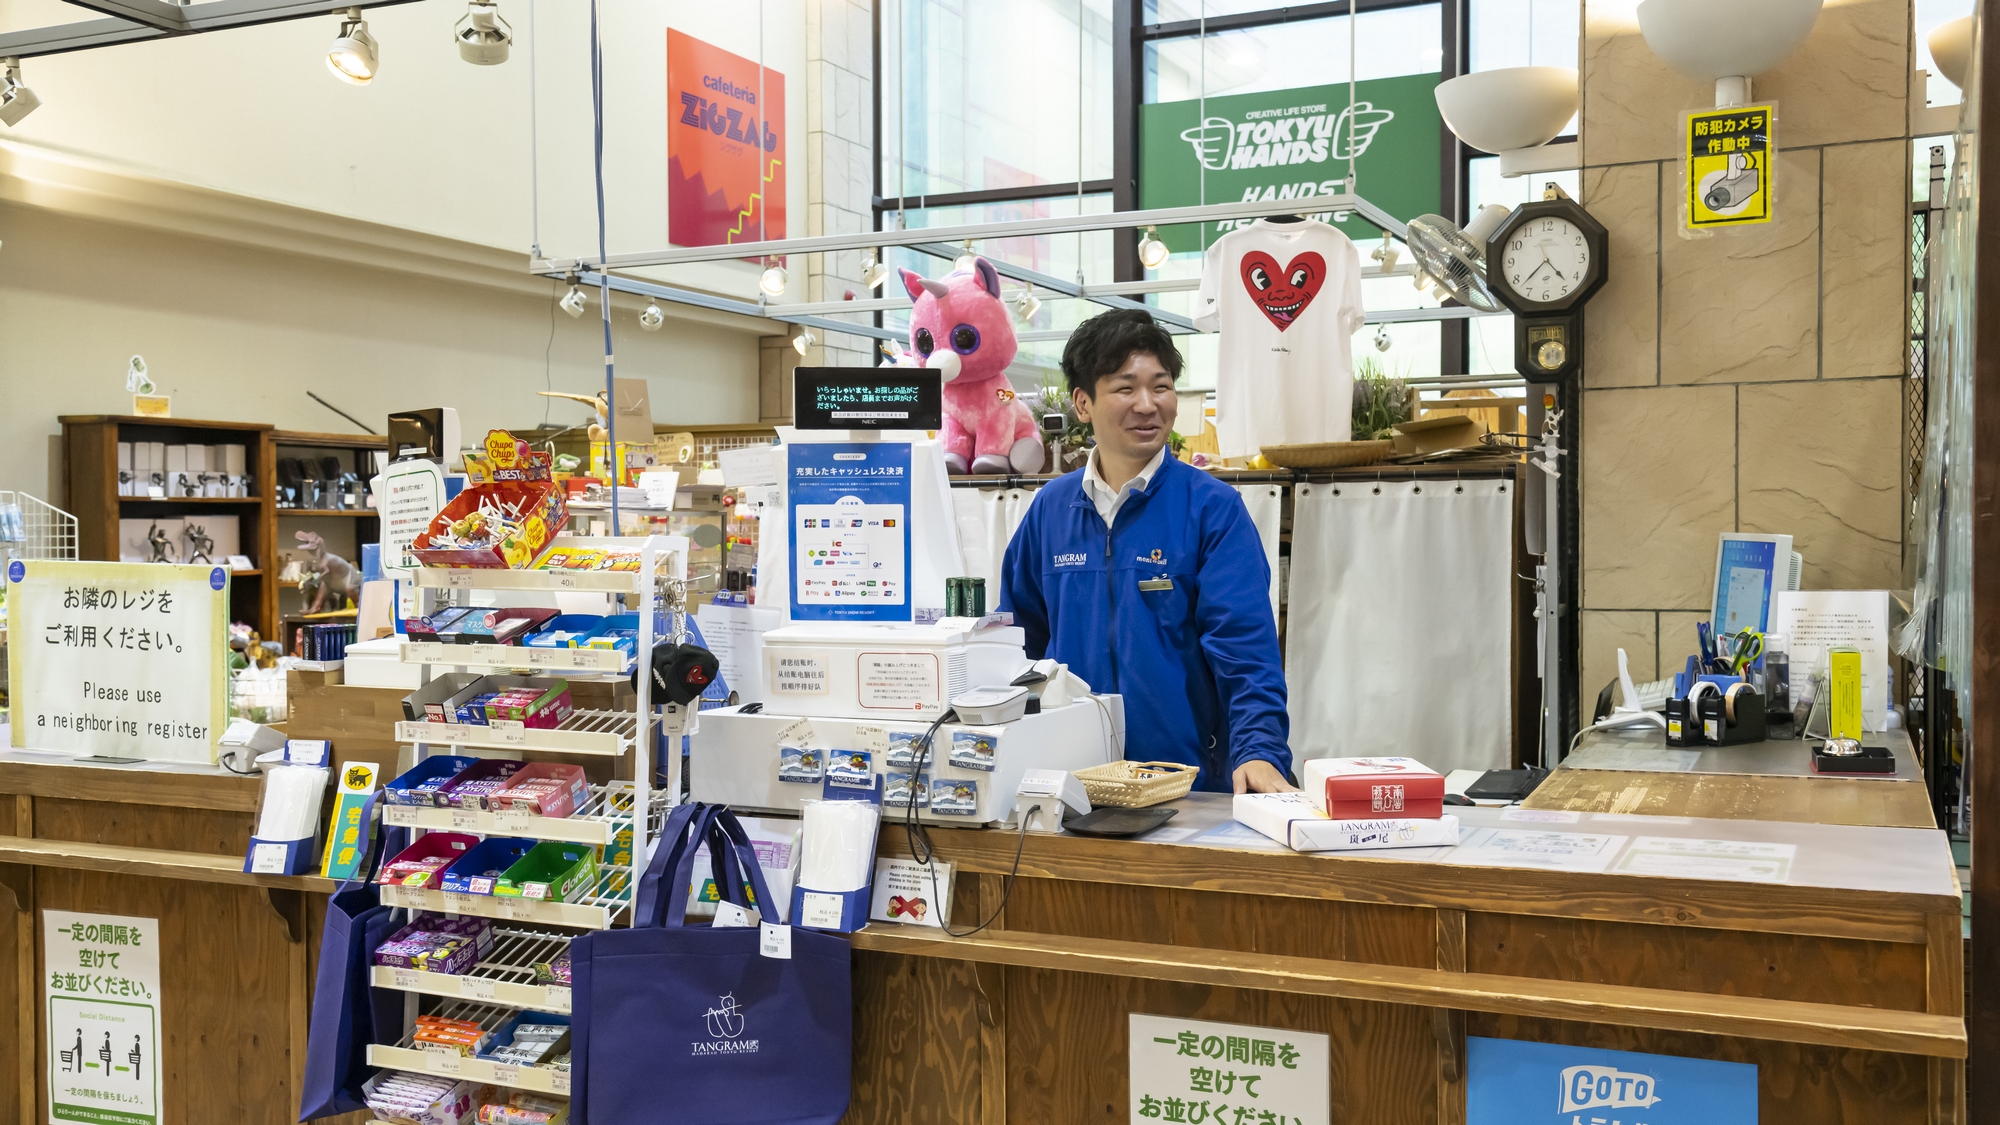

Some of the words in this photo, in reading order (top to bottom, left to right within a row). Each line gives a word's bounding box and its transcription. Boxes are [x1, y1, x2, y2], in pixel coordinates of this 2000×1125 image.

[703, 74, 756, 105] cafeteria
[1246, 108, 1282, 120] CREATIVE
[1283, 106, 1299, 117] LIFE
[1300, 104, 1327, 116] STORE
[1236, 114, 1336, 146] TOKYU
[1695, 116, 1763, 136] 防犯カメラ
[1708, 135, 1750, 154] 作動中
[1231, 138, 1330, 170] HANDS
[1241, 179, 1344, 202] HANDS
[1524, 226, 1533, 238] 11
[1541, 221, 1554, 232] 12
[1563, 224, 1568, 235] 1
[1511, 240, 1522, 251] 10
[1575, 236, 1582, 247] 2
[1507, 257, 1515, 269] 9
[1578, 253, 1586, 264] 3
[1512, 274, 1520, 285] 8
[1573, 271, 1580, 282] 4
[1526, 287, 1533, 298] 7
[1542, 290, 1550, 301] 6
[1560, 285, 1568, 296] 5
[816, 386, 919, 394] いらっしゃいませ。お探しの品がご
[816, 402, 841, 410] ださい。
[490, 440, 513, 450] Chupa
[491, 449, 515, 461] Chups
[500, 470, 520, 480] BEST
[796, 467, 904, 476] 充実したキャッシュレス決済
[1054, 553, 1087, 563] TANGRAM
[63, 586, 173, 614] お隣のレジを
[45, 623, 183, 653] ご利用ください。
[780, 658, 817, 667] 请您结账时，
[777, 670, 825, 679] 从结账电脑往后
[84, 681, 129, 701] Please
[137, 688, 162, 703] use
[781, 682, 822, 691] 按顺序排好队
[428, 713, 443, 721] No.1
[37, 714, 46, 727] a
[53, 712, 138, 737] neighboring
[147, 720, 208, 740] register
[954, 761, 981, 770] TANGRAM
[784, 775, 812, 783] TANGRAM
[831, 775, 859, 783] TANGRAM
[551, 792, 569, 811] XYLITOL
[1340, 821, 1390, 831] TANGRAM
[338, 806, 362, 865] 宅急便
[561, 860, 591, 896] Clorets
[57, 922, 142, 946] 一定の間隔を
[79, 948, 121, 969] 空けて
[51, 971, 152, 1000] お並びください。
[79, 1011, 98, 1020] Social
[99, 1013, 126, 1023] Distance
[691, 1040, 749, 1053] TANGRAM
[1153, 1030, 1301, 1070] 一定の間隔を
[1189, 1066, 1262, 1099] 空けて
[64, 1086, 143, 1105] 一定の間隔を保ちましょう。
